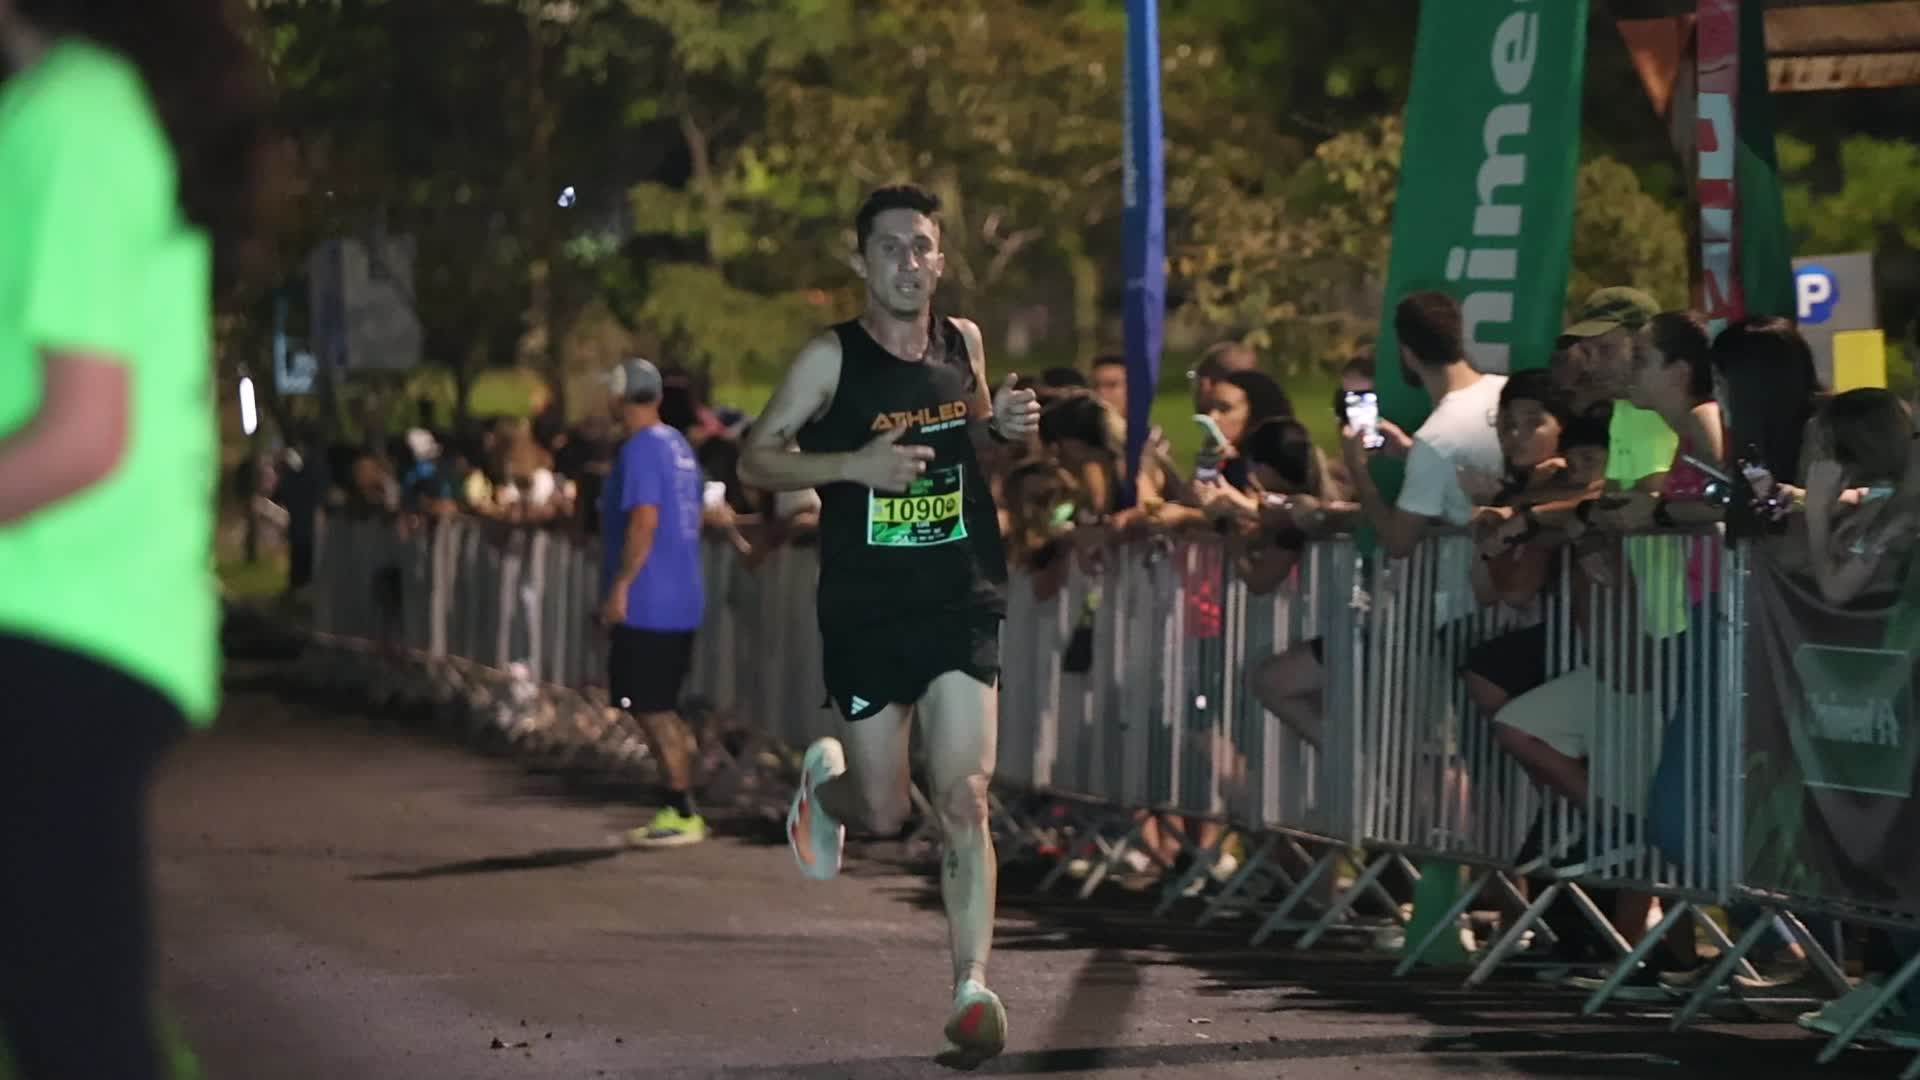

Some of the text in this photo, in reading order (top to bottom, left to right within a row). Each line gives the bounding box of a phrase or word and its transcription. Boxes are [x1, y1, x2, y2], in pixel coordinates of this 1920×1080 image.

[1796, 273, 1832, 319] P
[870, 400, 968, 431] ATHLED
[884, 497, 945, 521] 1090
